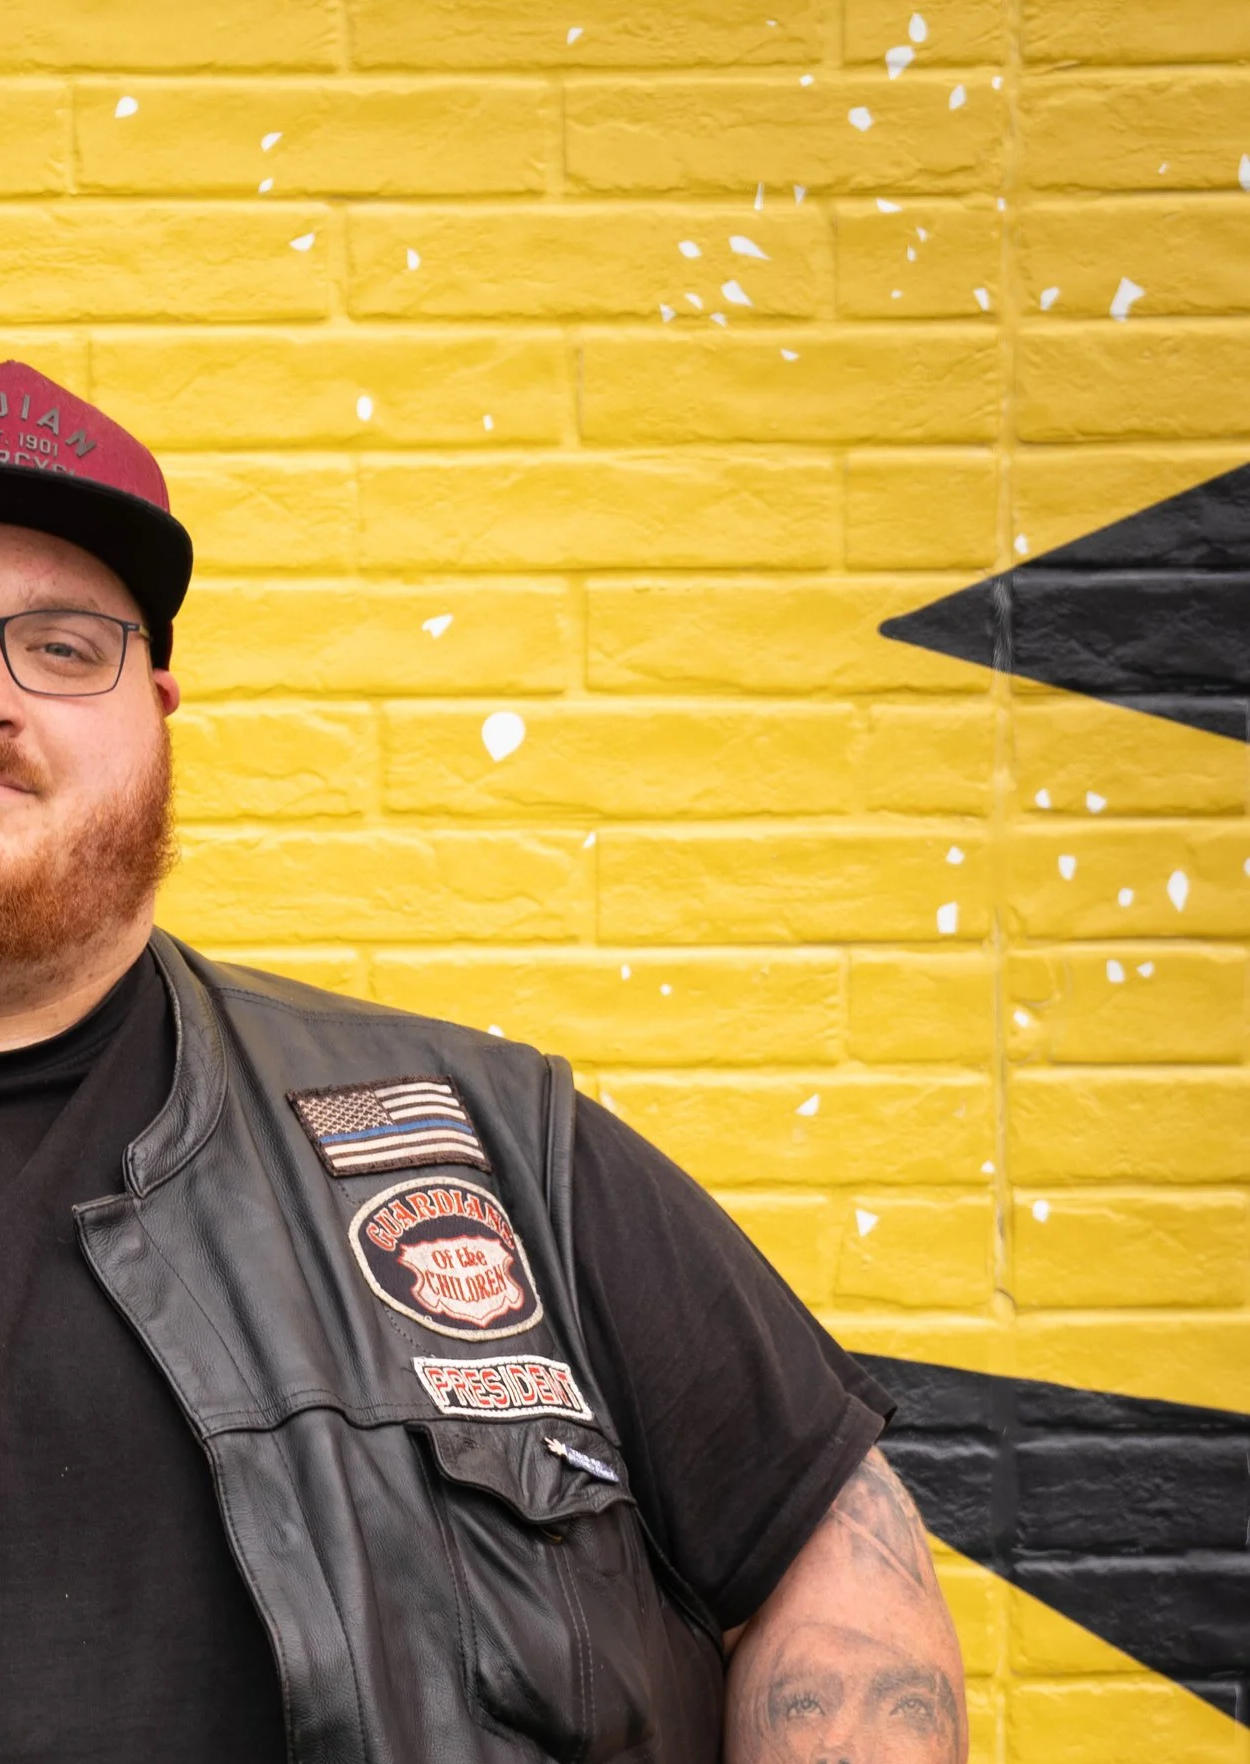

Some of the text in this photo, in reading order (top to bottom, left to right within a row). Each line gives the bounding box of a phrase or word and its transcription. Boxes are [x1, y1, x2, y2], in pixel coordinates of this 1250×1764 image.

[19, 432, 59, 457] 1901
[366, 1188, 516, 1251] GUARDIANS
[456, 1246, 488, 1267] the
[423, 1264, 508, 1303] CHILDREN
[424, 1364, 582, 1411] PRESIDENT
